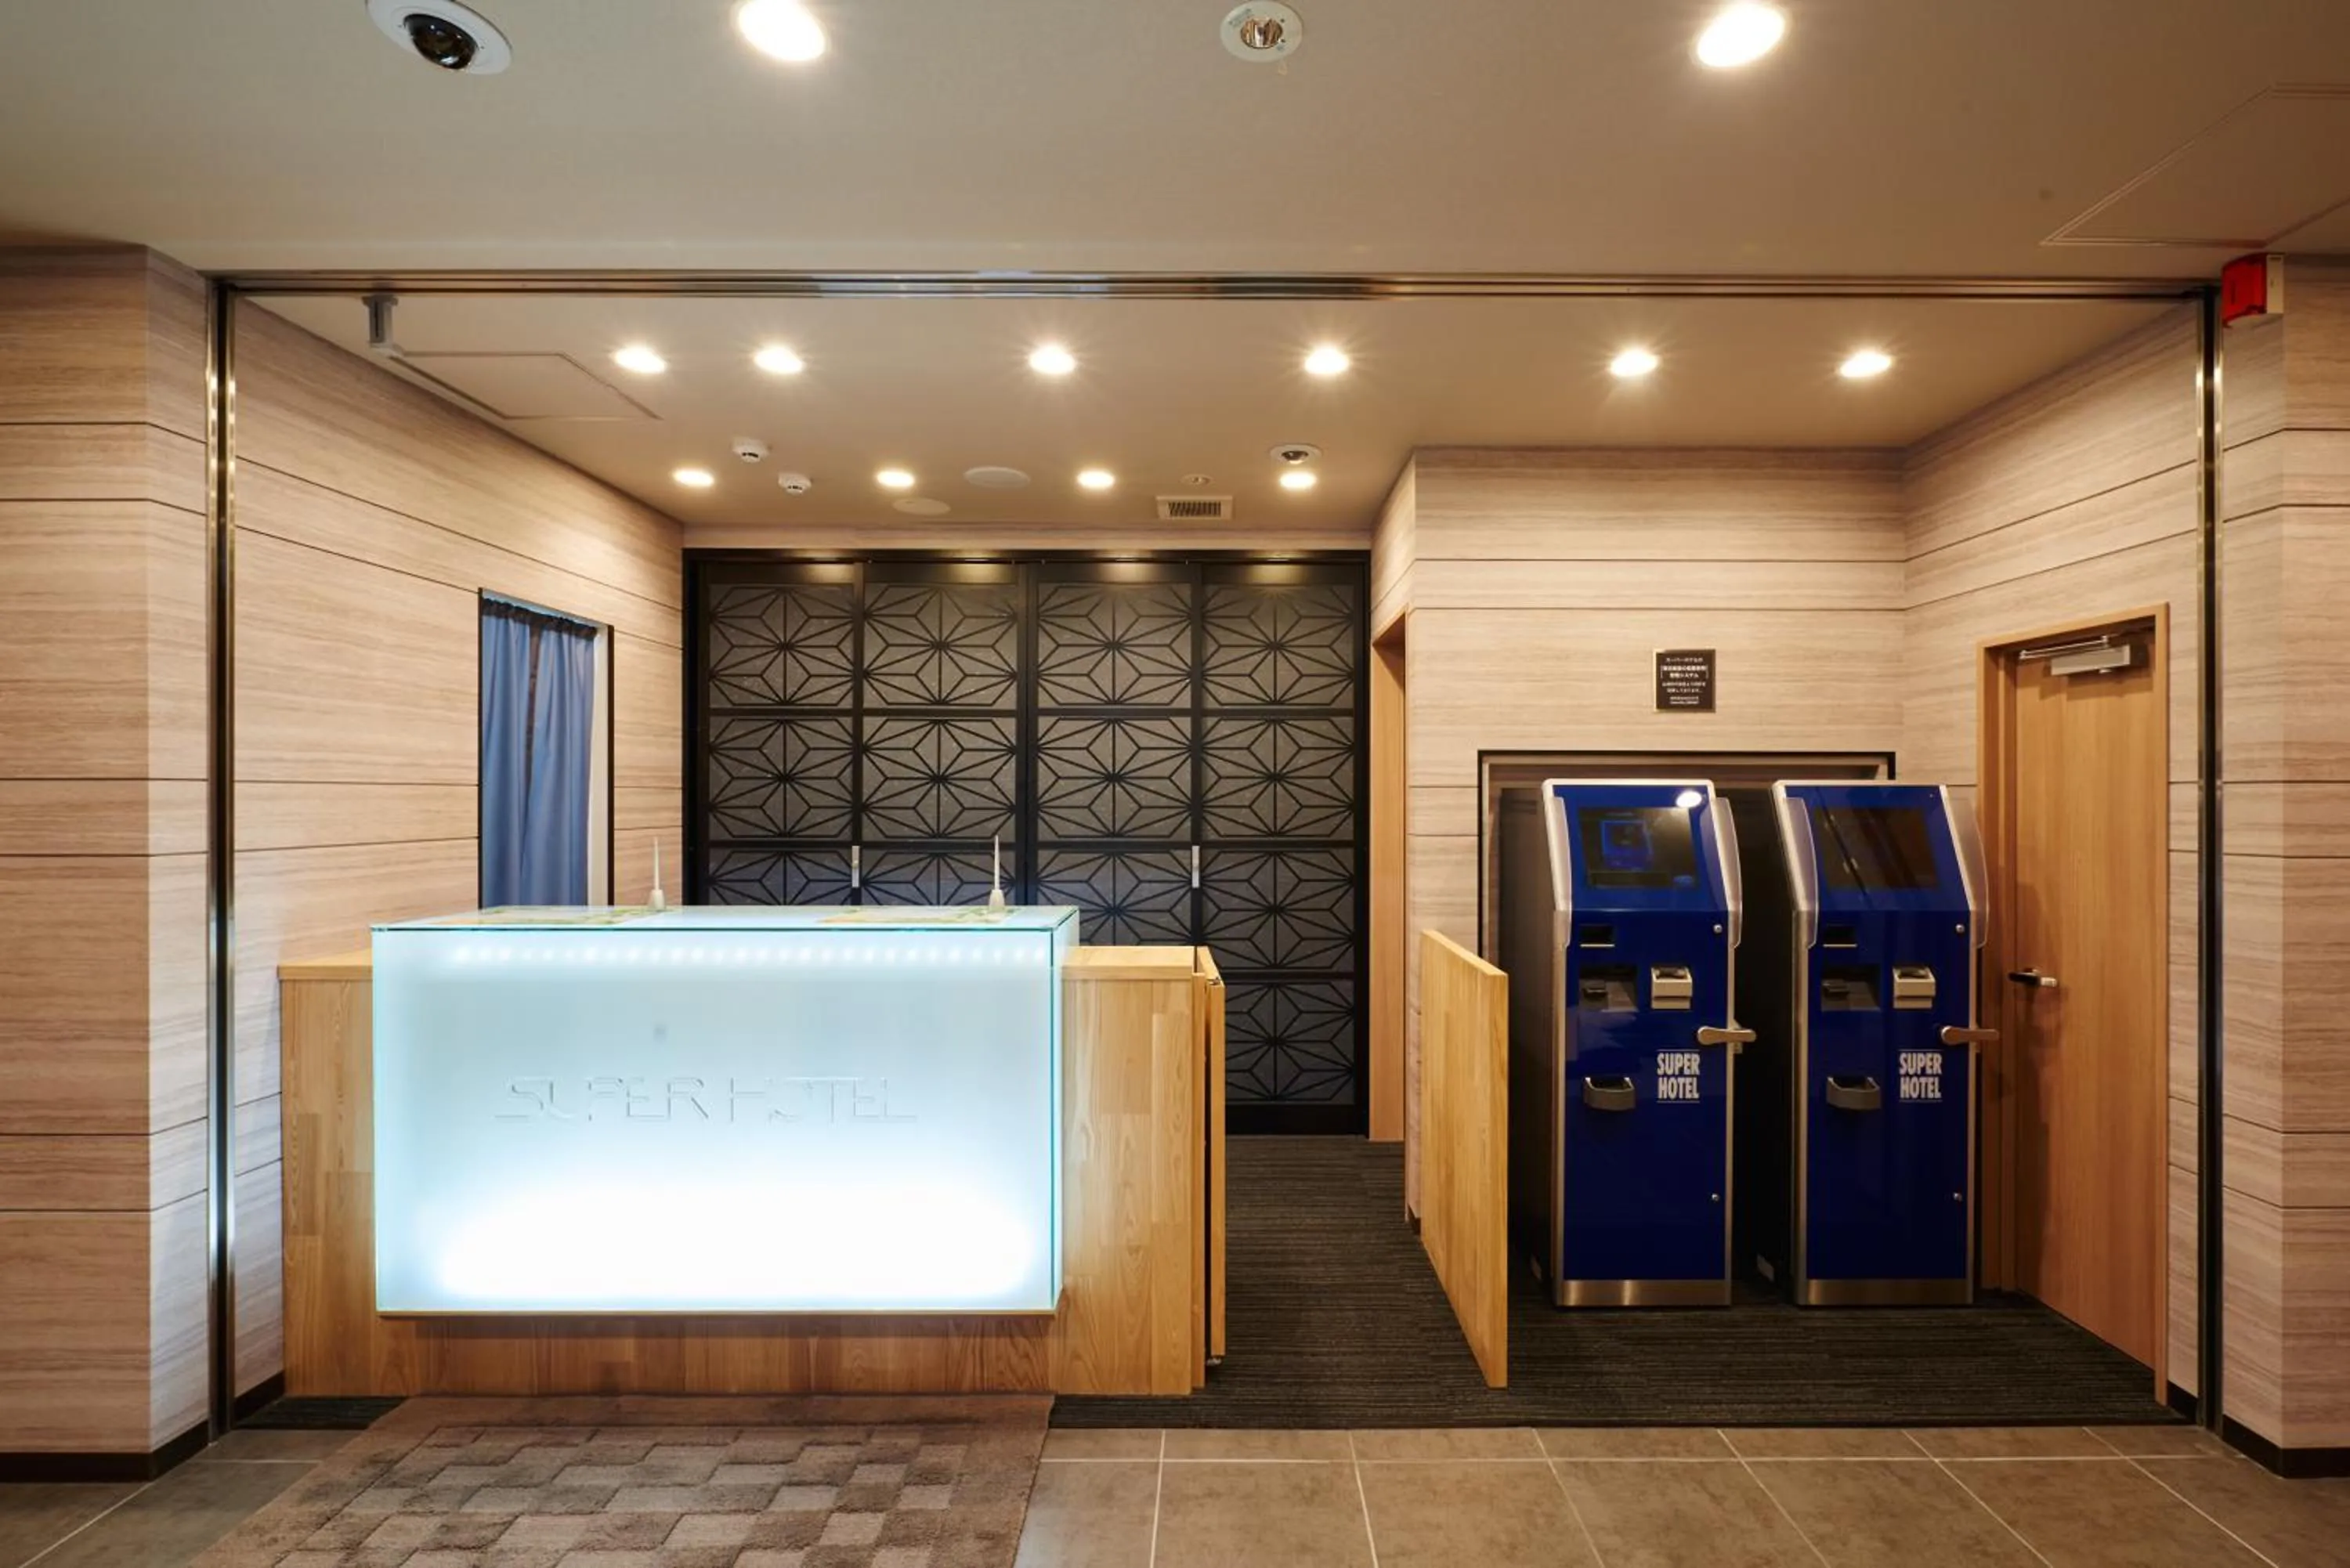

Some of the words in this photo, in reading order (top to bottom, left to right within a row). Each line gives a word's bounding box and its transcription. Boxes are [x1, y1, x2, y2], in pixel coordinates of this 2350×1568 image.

[1657, 1052, 1701, 1075] SUPER
[1899, 1052, 1943, 1075] SUPER
[1658, 1076, 1700, 1100] HOTEL
[1900, 1076, 1942, 1100] HOTEL
